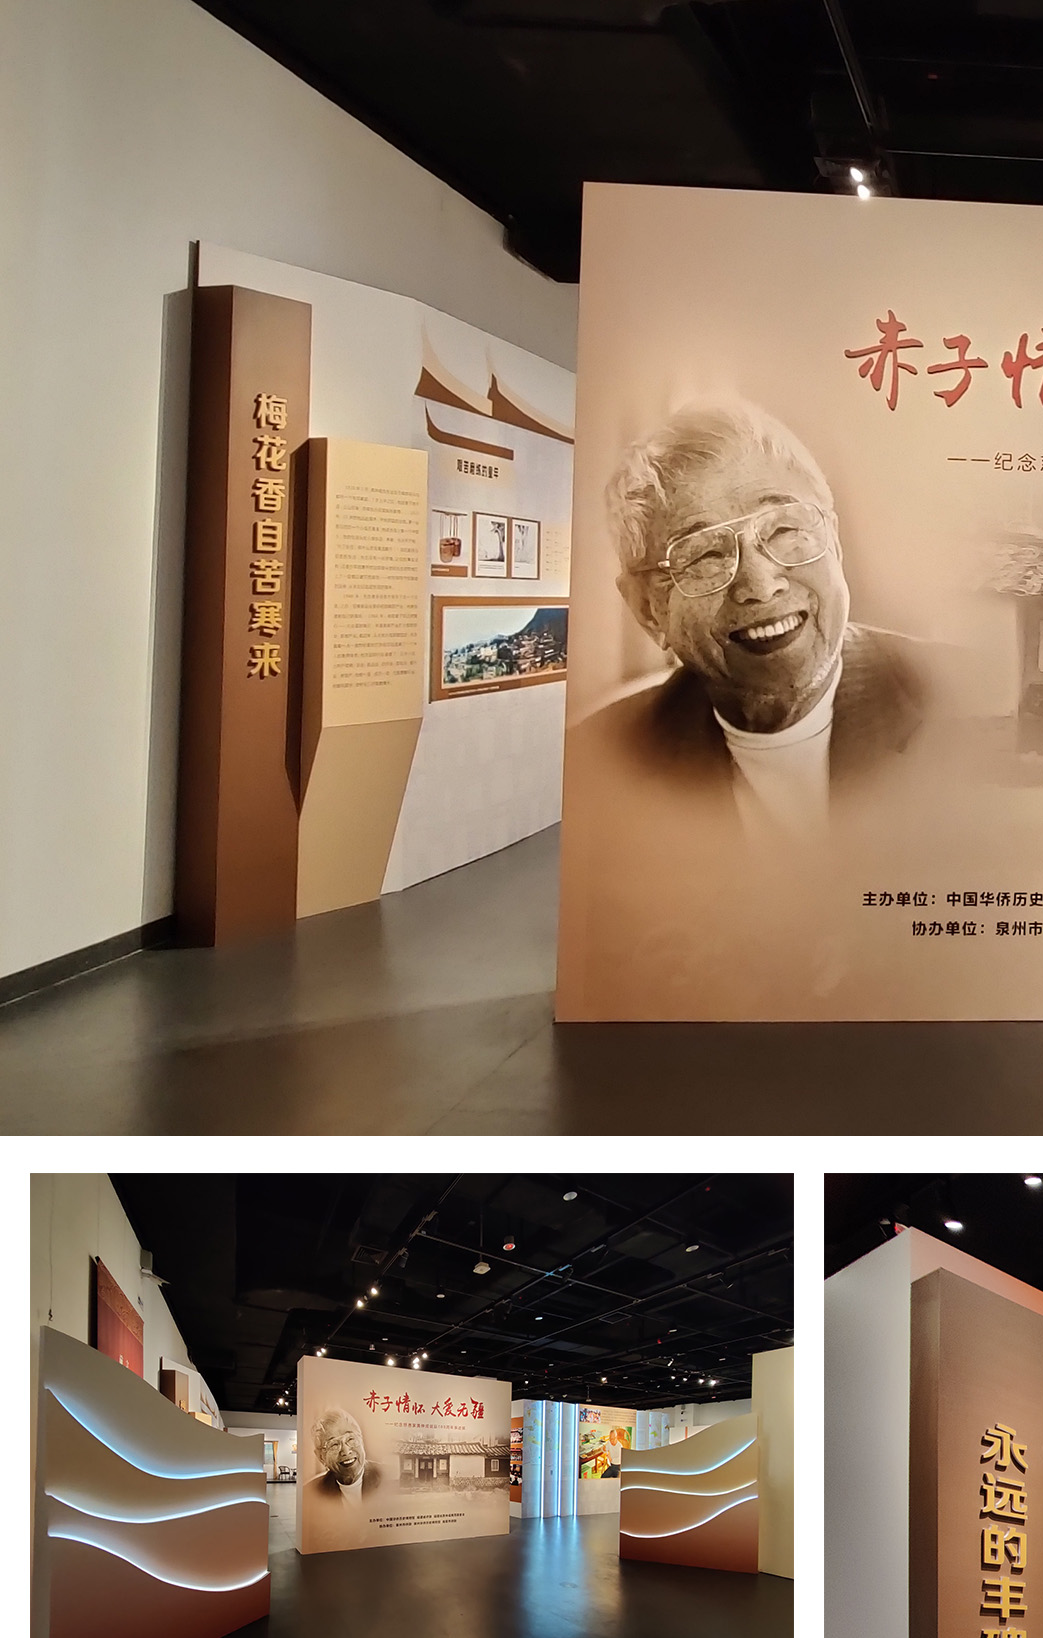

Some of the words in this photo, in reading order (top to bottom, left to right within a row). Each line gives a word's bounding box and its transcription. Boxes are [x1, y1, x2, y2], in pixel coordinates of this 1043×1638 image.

[245, 392, 289, 680] 梅花香自苦寒来
[363, 1390, 427, 1417] 赤子情怀
[430, 1395, 485, 1420] 大爱无疆
